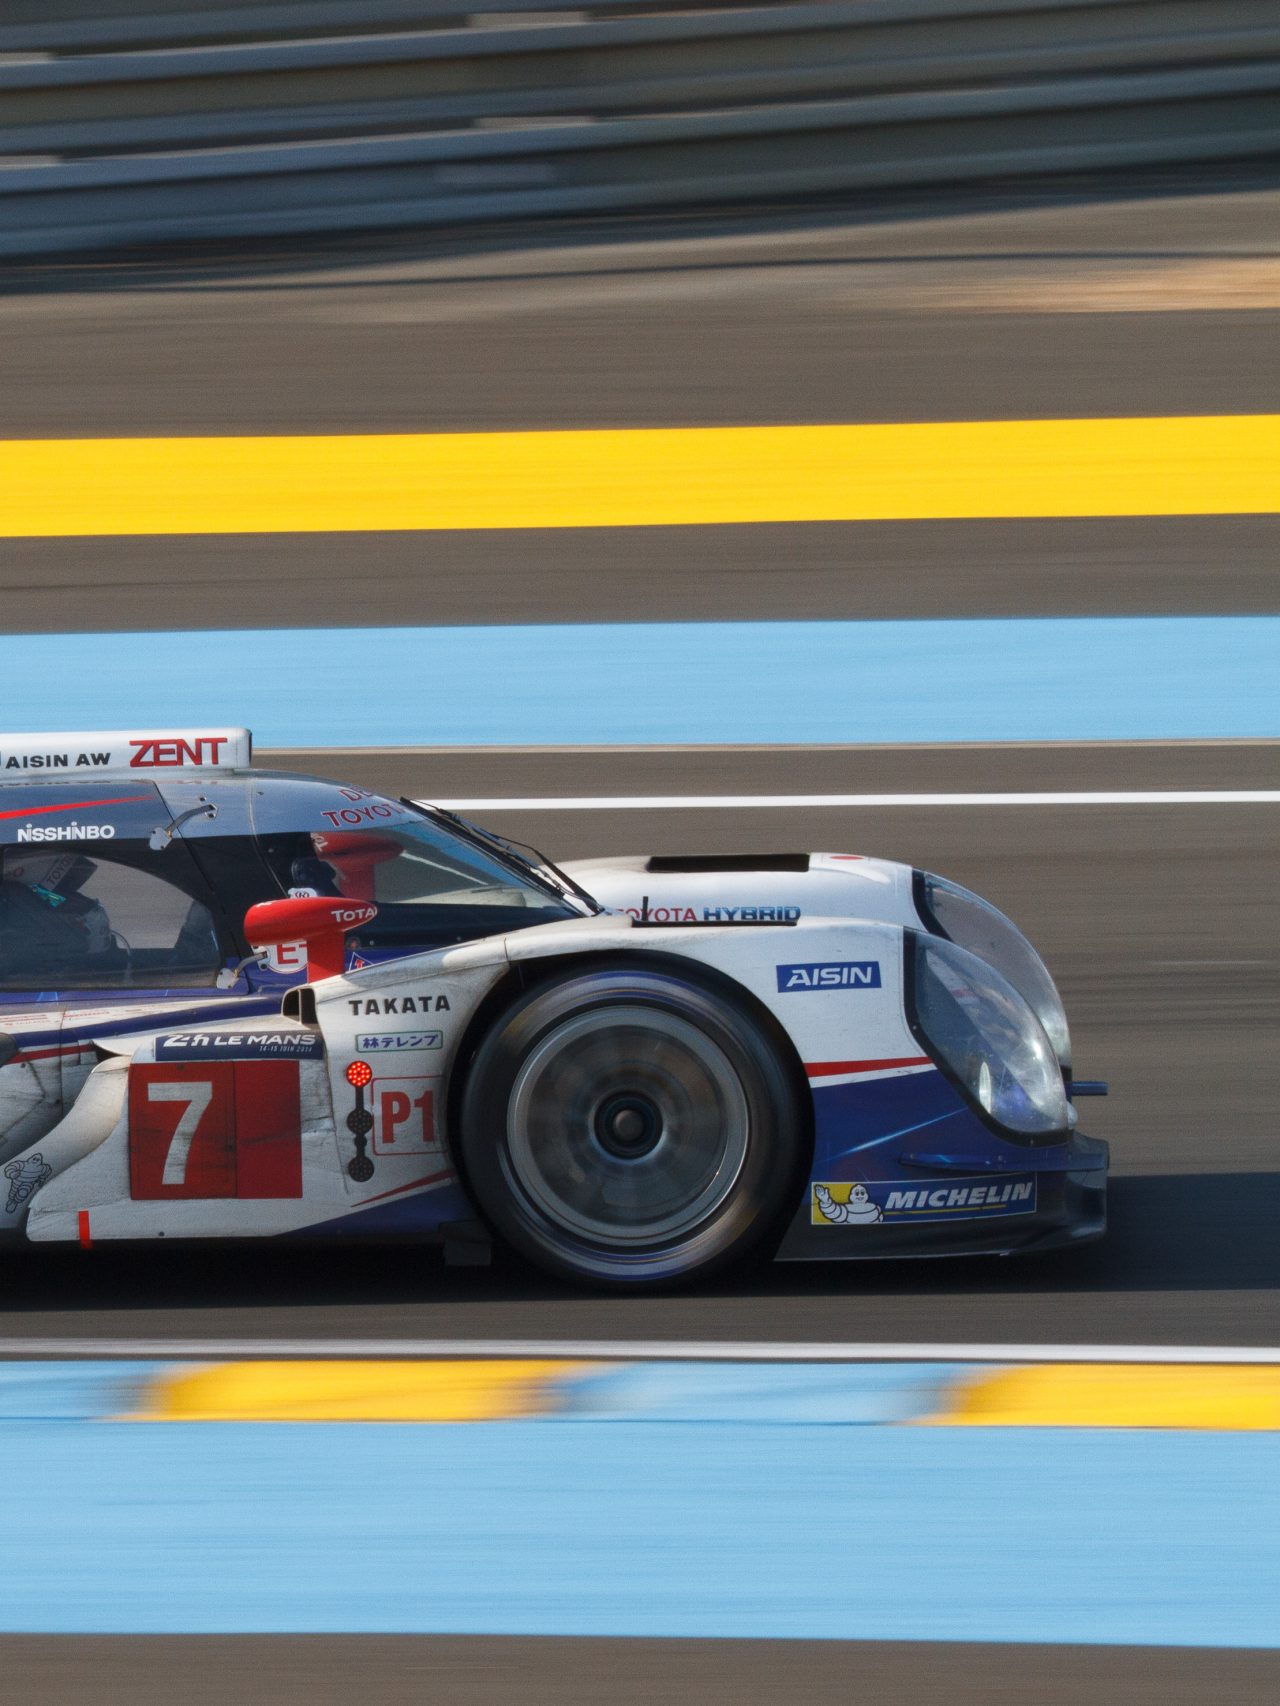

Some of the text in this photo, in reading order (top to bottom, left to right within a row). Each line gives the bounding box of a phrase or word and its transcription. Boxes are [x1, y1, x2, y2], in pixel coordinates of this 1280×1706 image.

[5, 754, 69, 769] AISIN
[75, 752, 111, 766] AW
[129, 737, 228, 767] ZENT
[618, 906, 801, 921] OYOTA HYBRID
[786, 966, 873, 987] AISIN
[349, 994, 451, 1016] TAKATA
[213, 1035, 243, 1046] LE
[246, 1034, 315, 1045] MANS
[363, 1034, 439, 1049] 林テレンプ
[381, 1090, 434, 1144] P1
[147, 1081, 213, 1185] 7
[885, 1182, 1032, 1209] MICHELIN
